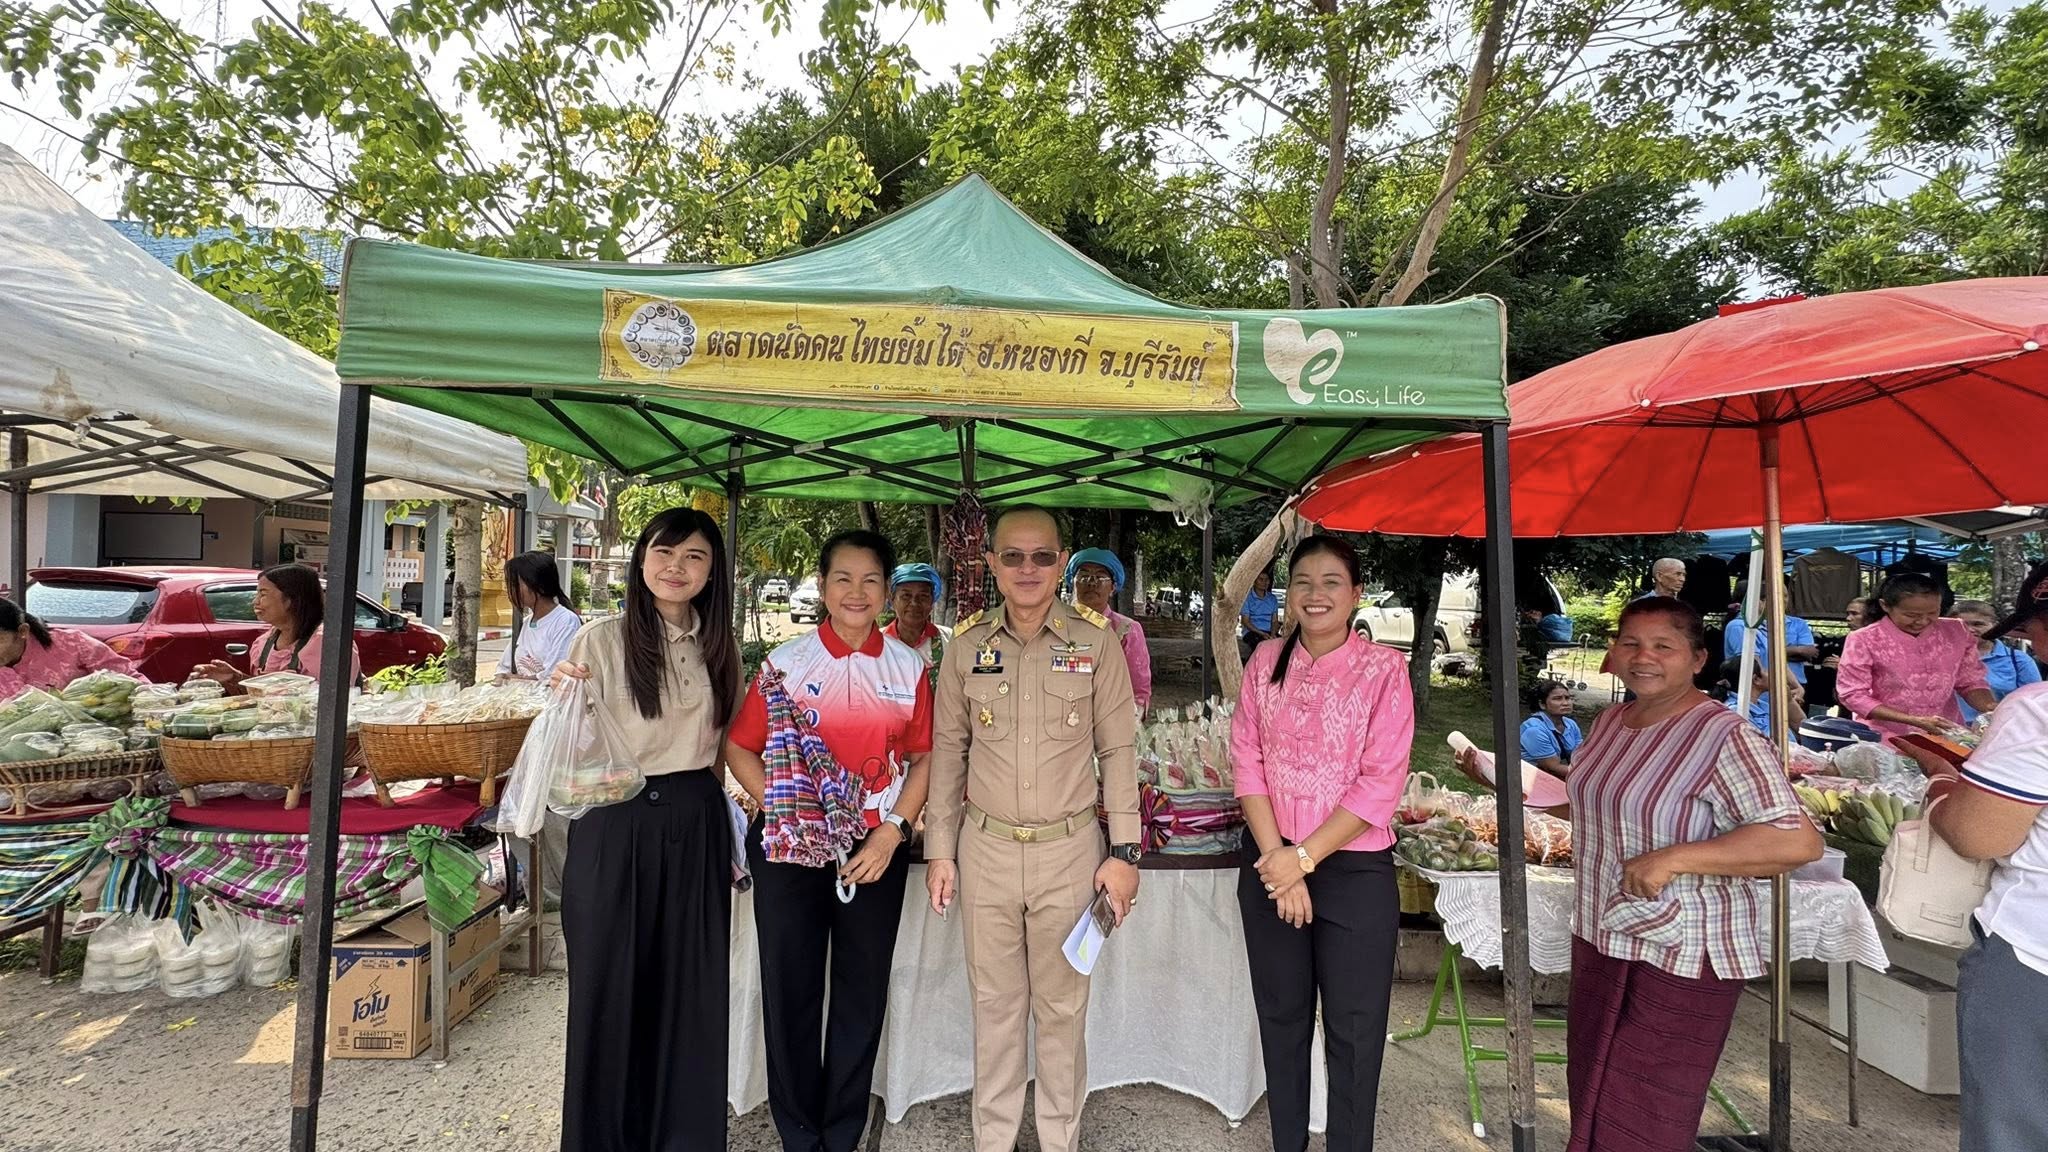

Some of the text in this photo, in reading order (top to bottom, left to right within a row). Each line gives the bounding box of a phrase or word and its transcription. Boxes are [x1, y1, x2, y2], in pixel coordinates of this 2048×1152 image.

[706, 315, 973, 368] ตลาดนัดคนไทยยิ้มได้
[976, 327, 1094, 375] อ.หนองกี่
[1324, 383, 1426, 408] Easy Life
[352, 990, 390, 1023] โอโม
